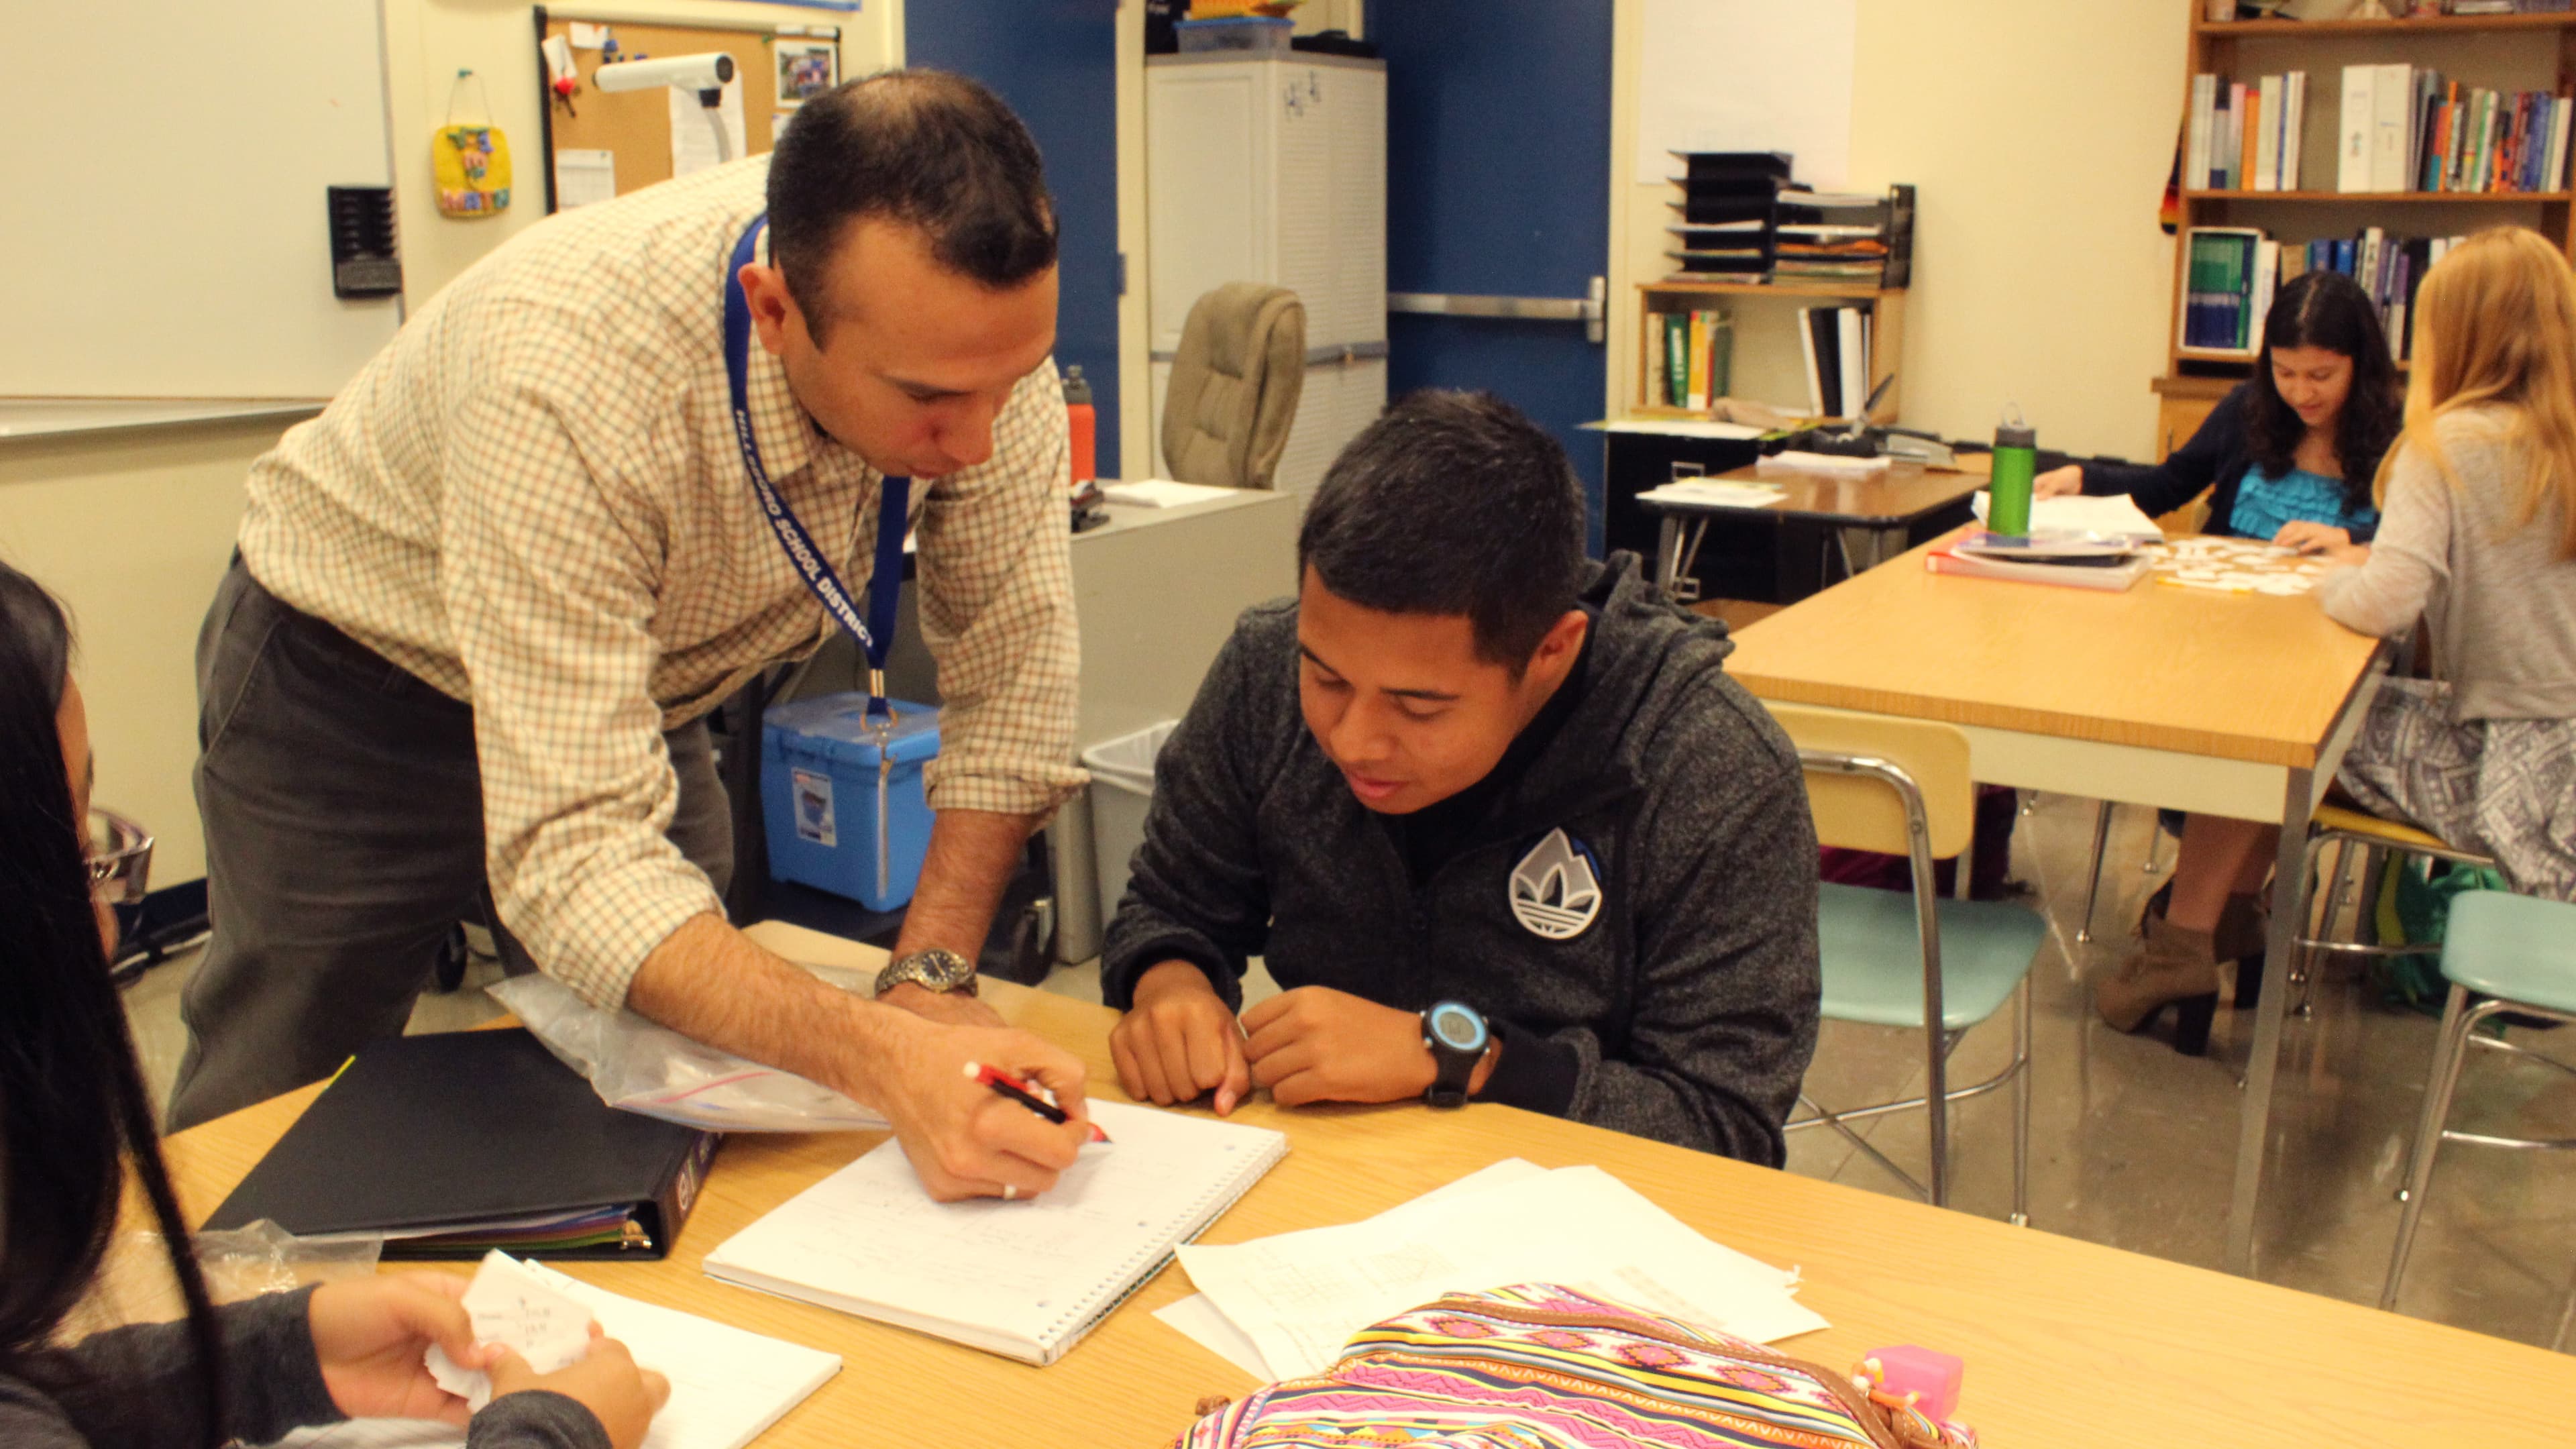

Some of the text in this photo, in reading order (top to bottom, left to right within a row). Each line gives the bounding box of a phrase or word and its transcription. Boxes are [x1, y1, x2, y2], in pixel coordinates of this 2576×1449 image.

[441, 189, 511, 210] MATH
[736, 409, 782, 517] HILLSBORO
[775, 519, 822, 581] SCHOOL
